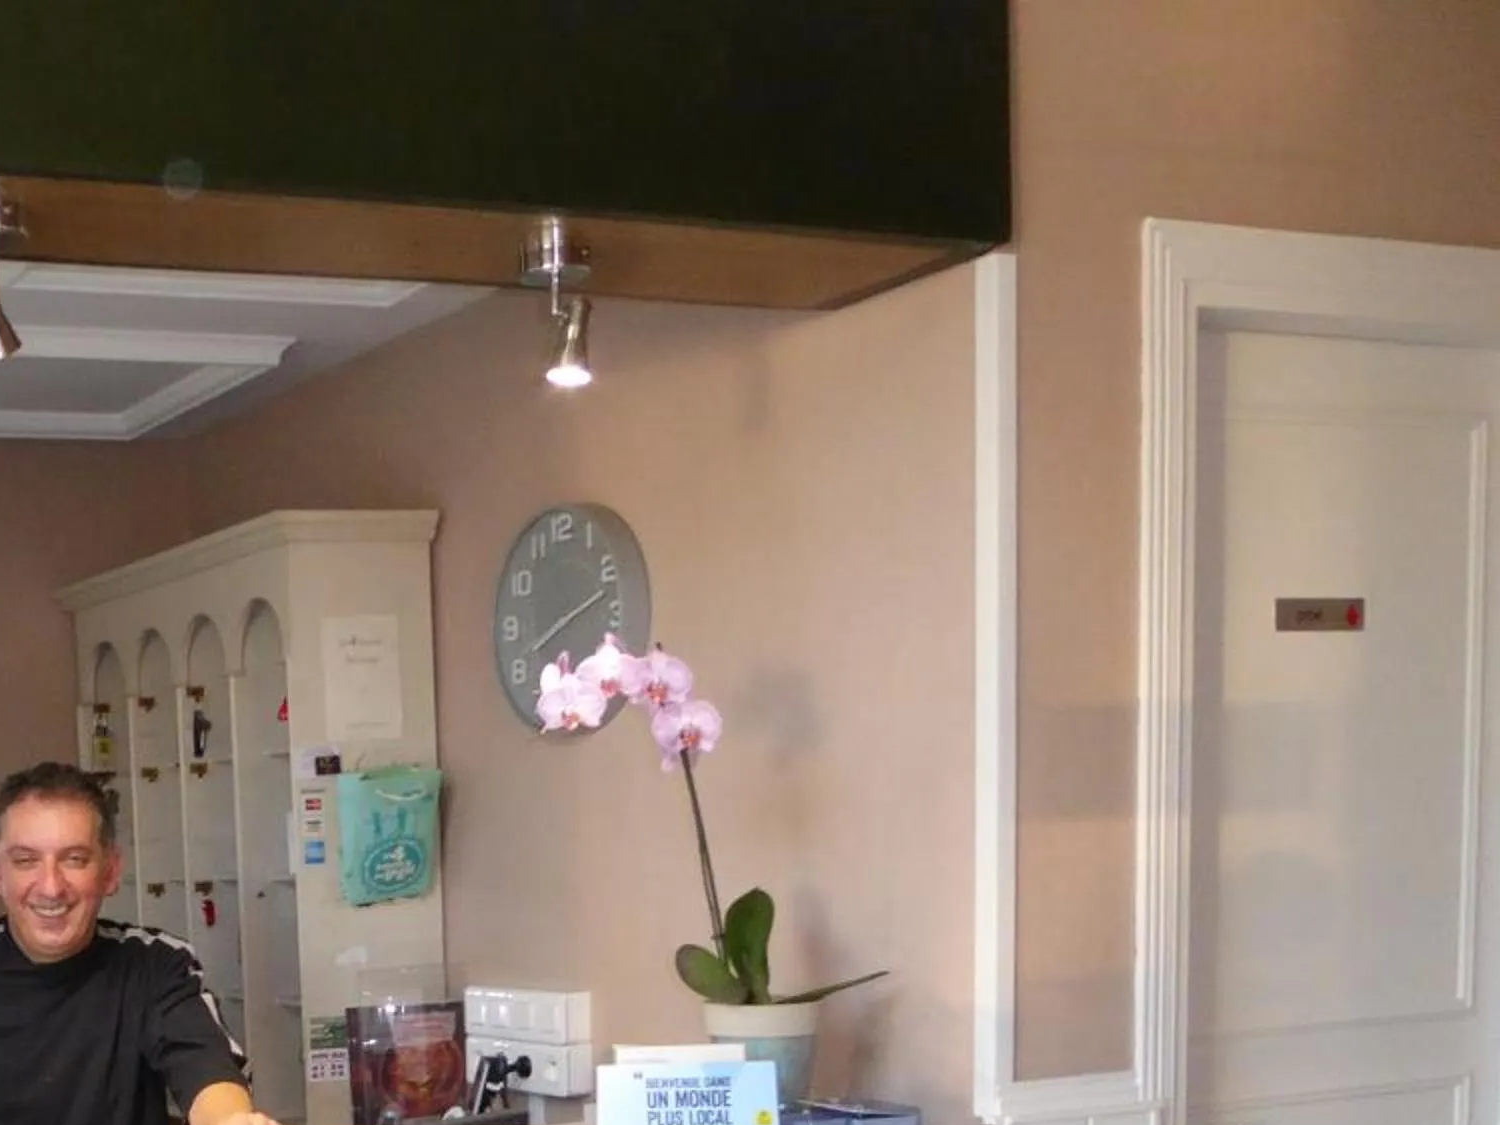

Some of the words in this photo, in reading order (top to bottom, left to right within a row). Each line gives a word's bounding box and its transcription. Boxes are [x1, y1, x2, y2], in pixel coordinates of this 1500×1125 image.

[551, 512, 573, 542] 12
[585, 521, 593, 550] 1
[531, 533, 546, 559] 11
[600, 554, 618, 582] 2
[511, 570, 533, 596] 10
[609, 600, 623, 628] 3
[502, 616, 519, 641] 9
[511, 659, 527, 684] 8
[646, 1091, 669, 1108] UN
[675, 1090, 733, 1108] MONDE
[688, 1109, 734, 1125] LOCAL
